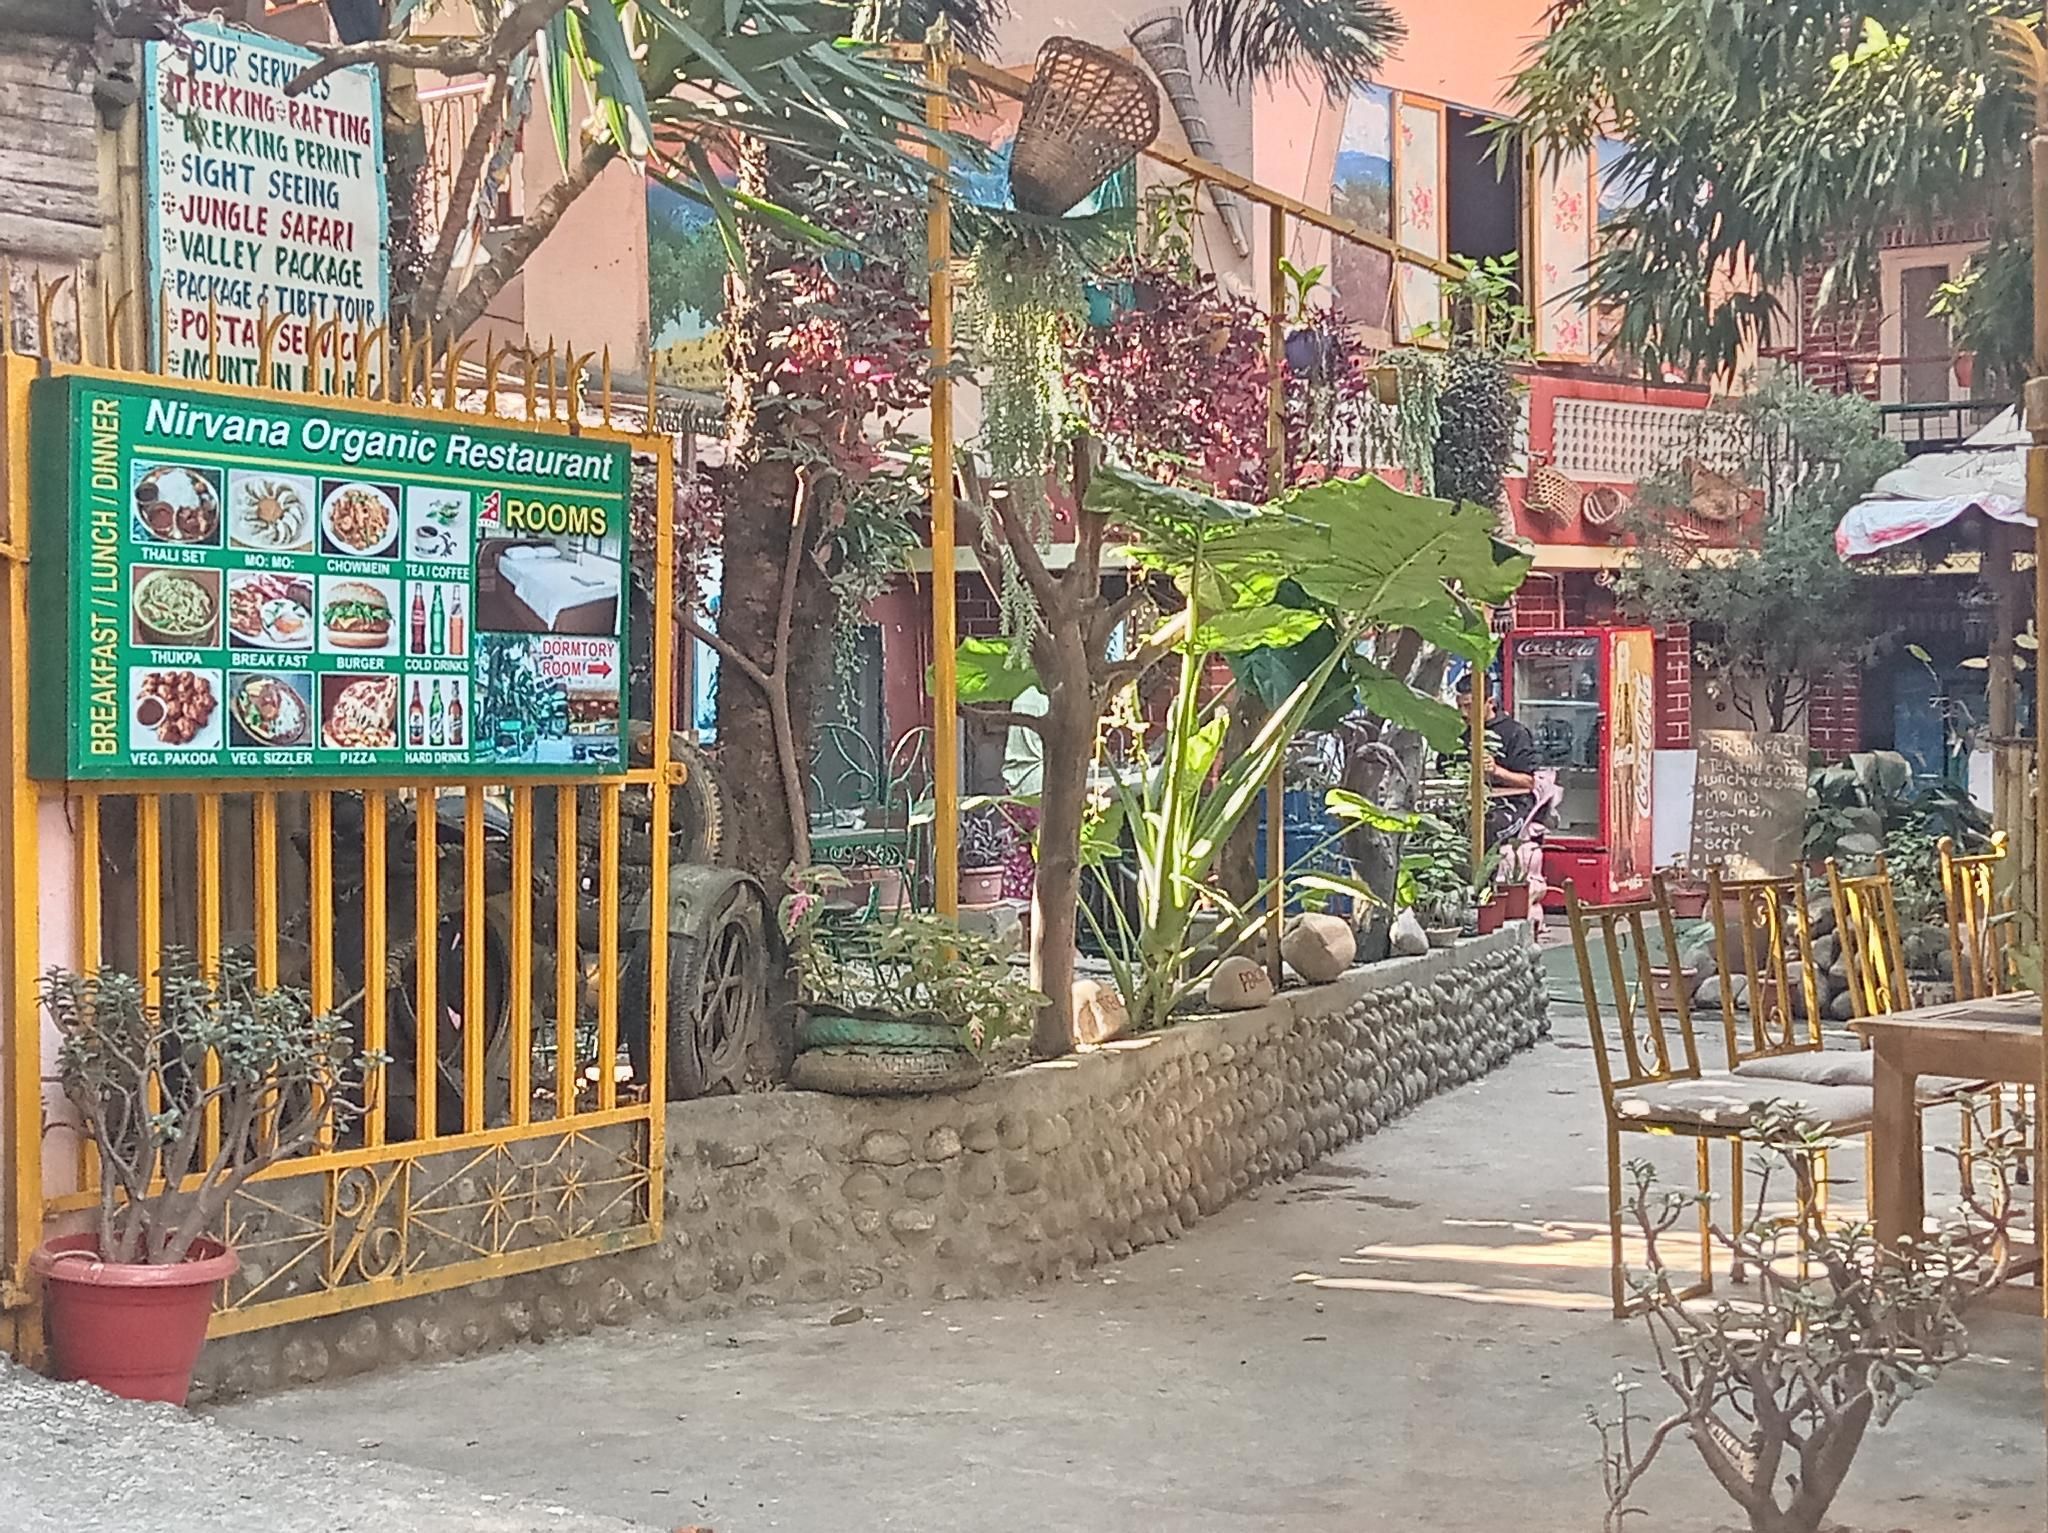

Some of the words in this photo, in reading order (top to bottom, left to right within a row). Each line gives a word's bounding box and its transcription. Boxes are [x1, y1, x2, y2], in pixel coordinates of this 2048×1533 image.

[191, 40, 239, 78] OUR
[171, 74, 276, 123] TREKKING
[288, 100, 371, 145] RAFTING
[294, 139, 362, 179] PERMIT
[181, 154, 255, 195] SIGHT
[268, 169, 339, 210] SEEING
[179, 195, 268, 237] JUNGLE
[280, 210, 354, 252] SAFARI
[180, 230, 263, 272] VALLEY
[275, 246, 364, 289] PACKAGE
[177, 269, 252, 309] PACKAGE
[275, 285, 328, 319] TIBET
[333, 294, 377, 327] TOUR
[181, 308, 259, 348] POSTA
[278, 323, 358, 362] SEVC
[183, 348, 292, 391] MOUNTIN
[91, 398, 120, 491] DINNER
[145, 398, 290, 447] Nirvana
[302, 418, 437, 463] Organic
[446, 433, 613, 481] Restaurant
[506, 499, 607, 536] ROOMS
[91, 510, 119, 592] LUNCH
[142, 547, 180, 563] THALI
[182, 549, 207, 564] SET
[326, 560, 390, 575] CHOWMEIN
[151, 651, 202, 664] THUKPA
[232, 653, 275, 667] BREAK
[277, 655, 308, 668] FAST
[336, 656, 385, 670] BURGER
[405, 658, 431, 671] COLD
[433, 660, 469, 672] DRINKS
[542, 661, 581, 676] ROOM
[91, 612, 119, 755] BREAKFAST
[130, 753, 162, 765] VEG.
[164, 753, 218, 765] PAKODA
[263, 752, 313, 765] SIZZLER
[340, 752, 377, 764] PIZZA
[405, 752, 433, 764] HARD
[435, 752, 470, 764] DRINKS
